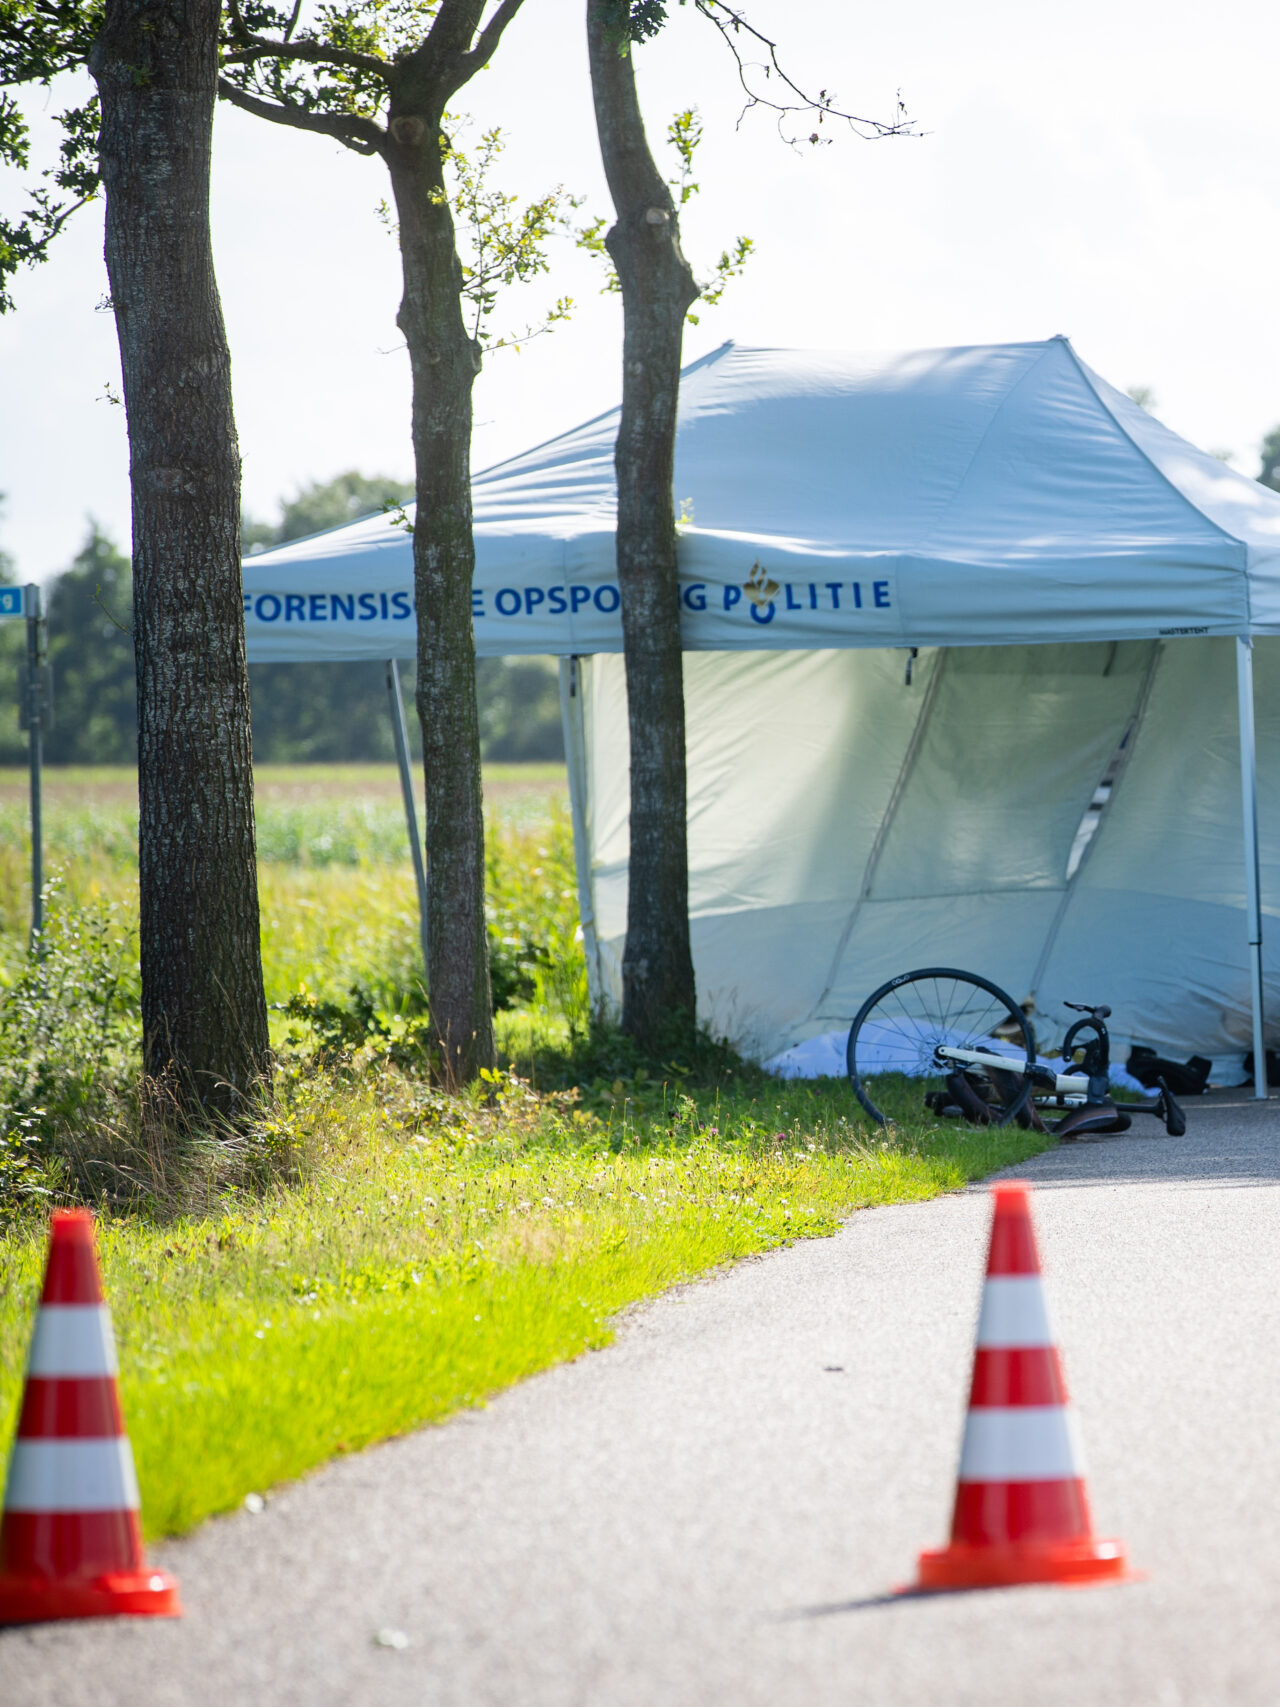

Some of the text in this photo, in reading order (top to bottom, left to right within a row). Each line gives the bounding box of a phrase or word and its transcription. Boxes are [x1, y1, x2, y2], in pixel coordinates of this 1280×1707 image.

[244, 581, 891, 625] ORENSISE OPSPOG POLITIE
